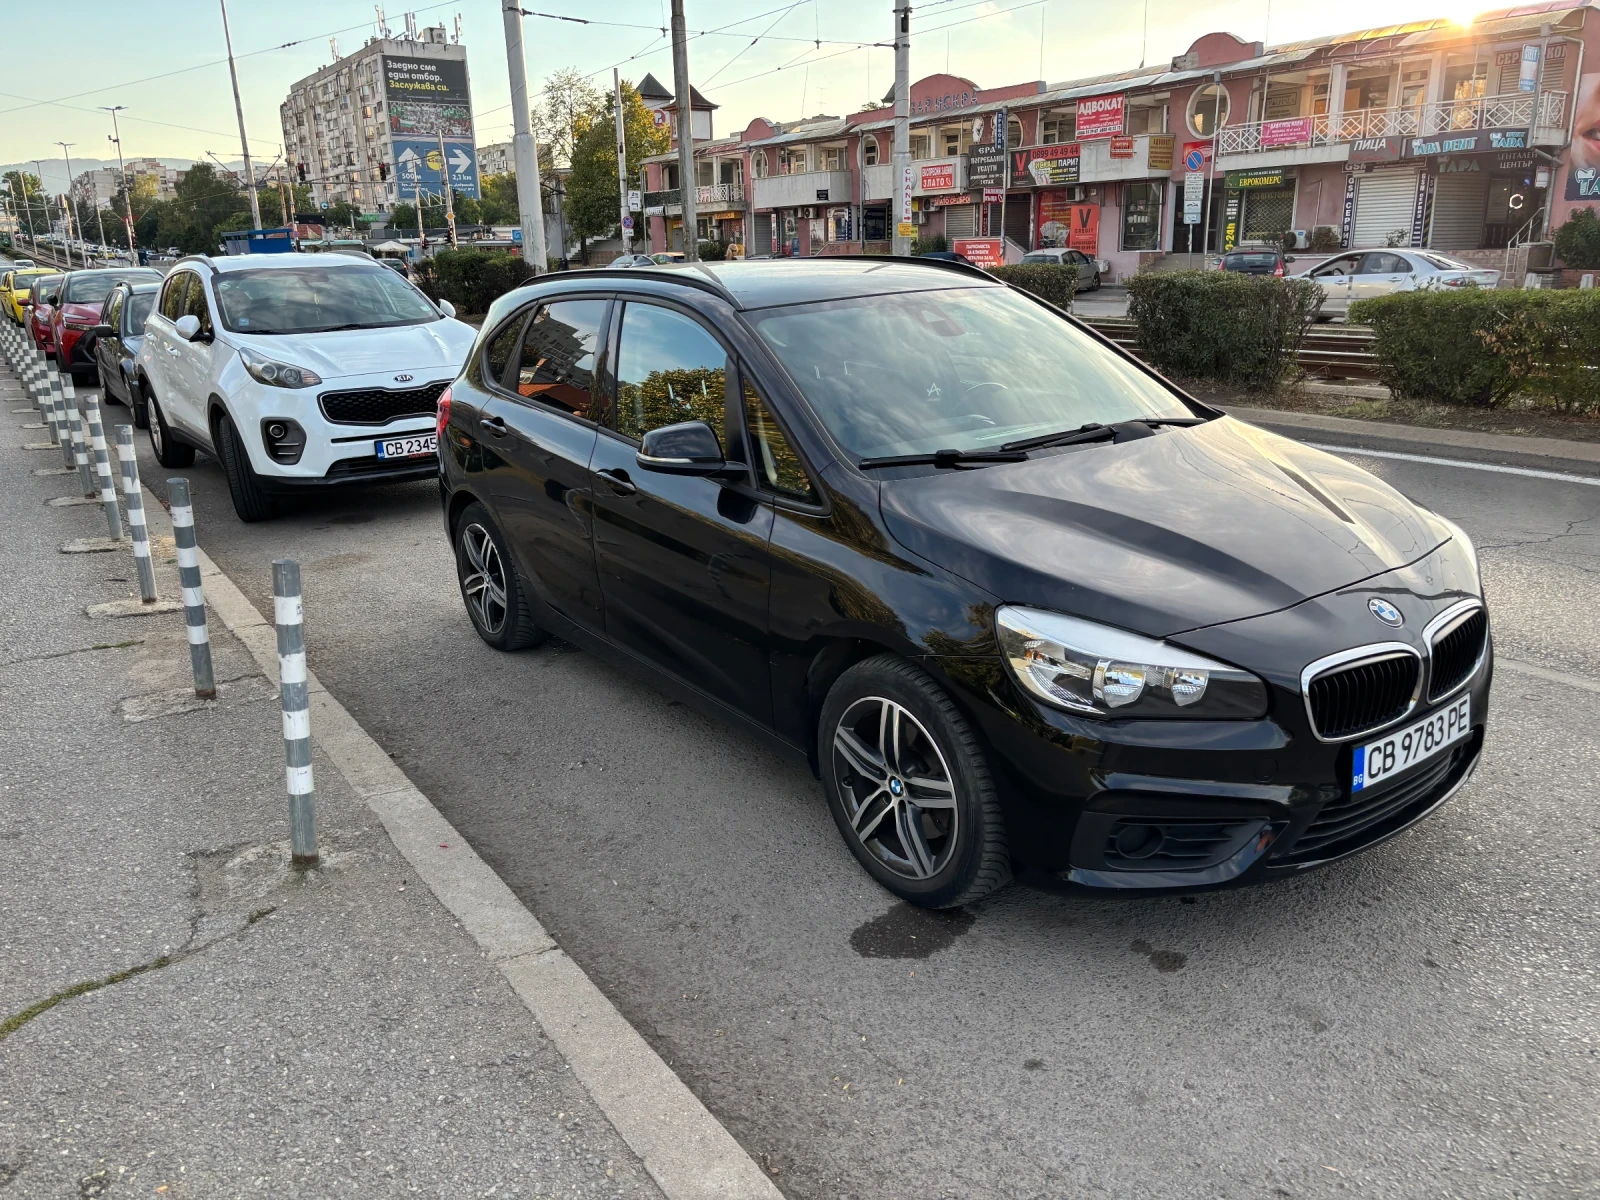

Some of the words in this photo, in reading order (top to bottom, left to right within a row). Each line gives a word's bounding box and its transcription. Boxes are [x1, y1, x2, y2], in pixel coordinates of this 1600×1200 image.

[386, 60, 418, 71] Заедно
[388, 71, 409, 80] един
[411, 72, 443, 82] отбор.
[389, 80, 435, 91] Заслужава
[1078, 97, 1123, 115] АДВОКАТ
[1354, 138, 1386, 151] ПИЦА
[1443, 137, 1478, 152] DENT
[1032, 150, 1048, 159] 0899
[1070, 146, 1078, 154] 44
[1015, 153, 1027, 171] V
[1058, 158, 1078, 167] ПАРИ?
[1500, 160, 1533, 169] ЦЕНТЪР
[977, 165, 997, 173] УСЛУГИ
[923, 177, 945, 188] ЗЛАТО
[1239, 175, 1282, 187] ЕВРОКОМЕРС
[1346, 178, 1355, 198] GSM
[1079, 208, 1091, 228] V
[1342, 202, 1352, 247] СЕРВИЗ
[385, 442, 404, 456] CB
[406, 437, 437, 454] 2345
[1368, 740, 1396, 780] CB
[1401, 715, 1444, 765] 9783
[1448, 698, 1468, 740] PE
[1353, 773, 1363, 785] BG
